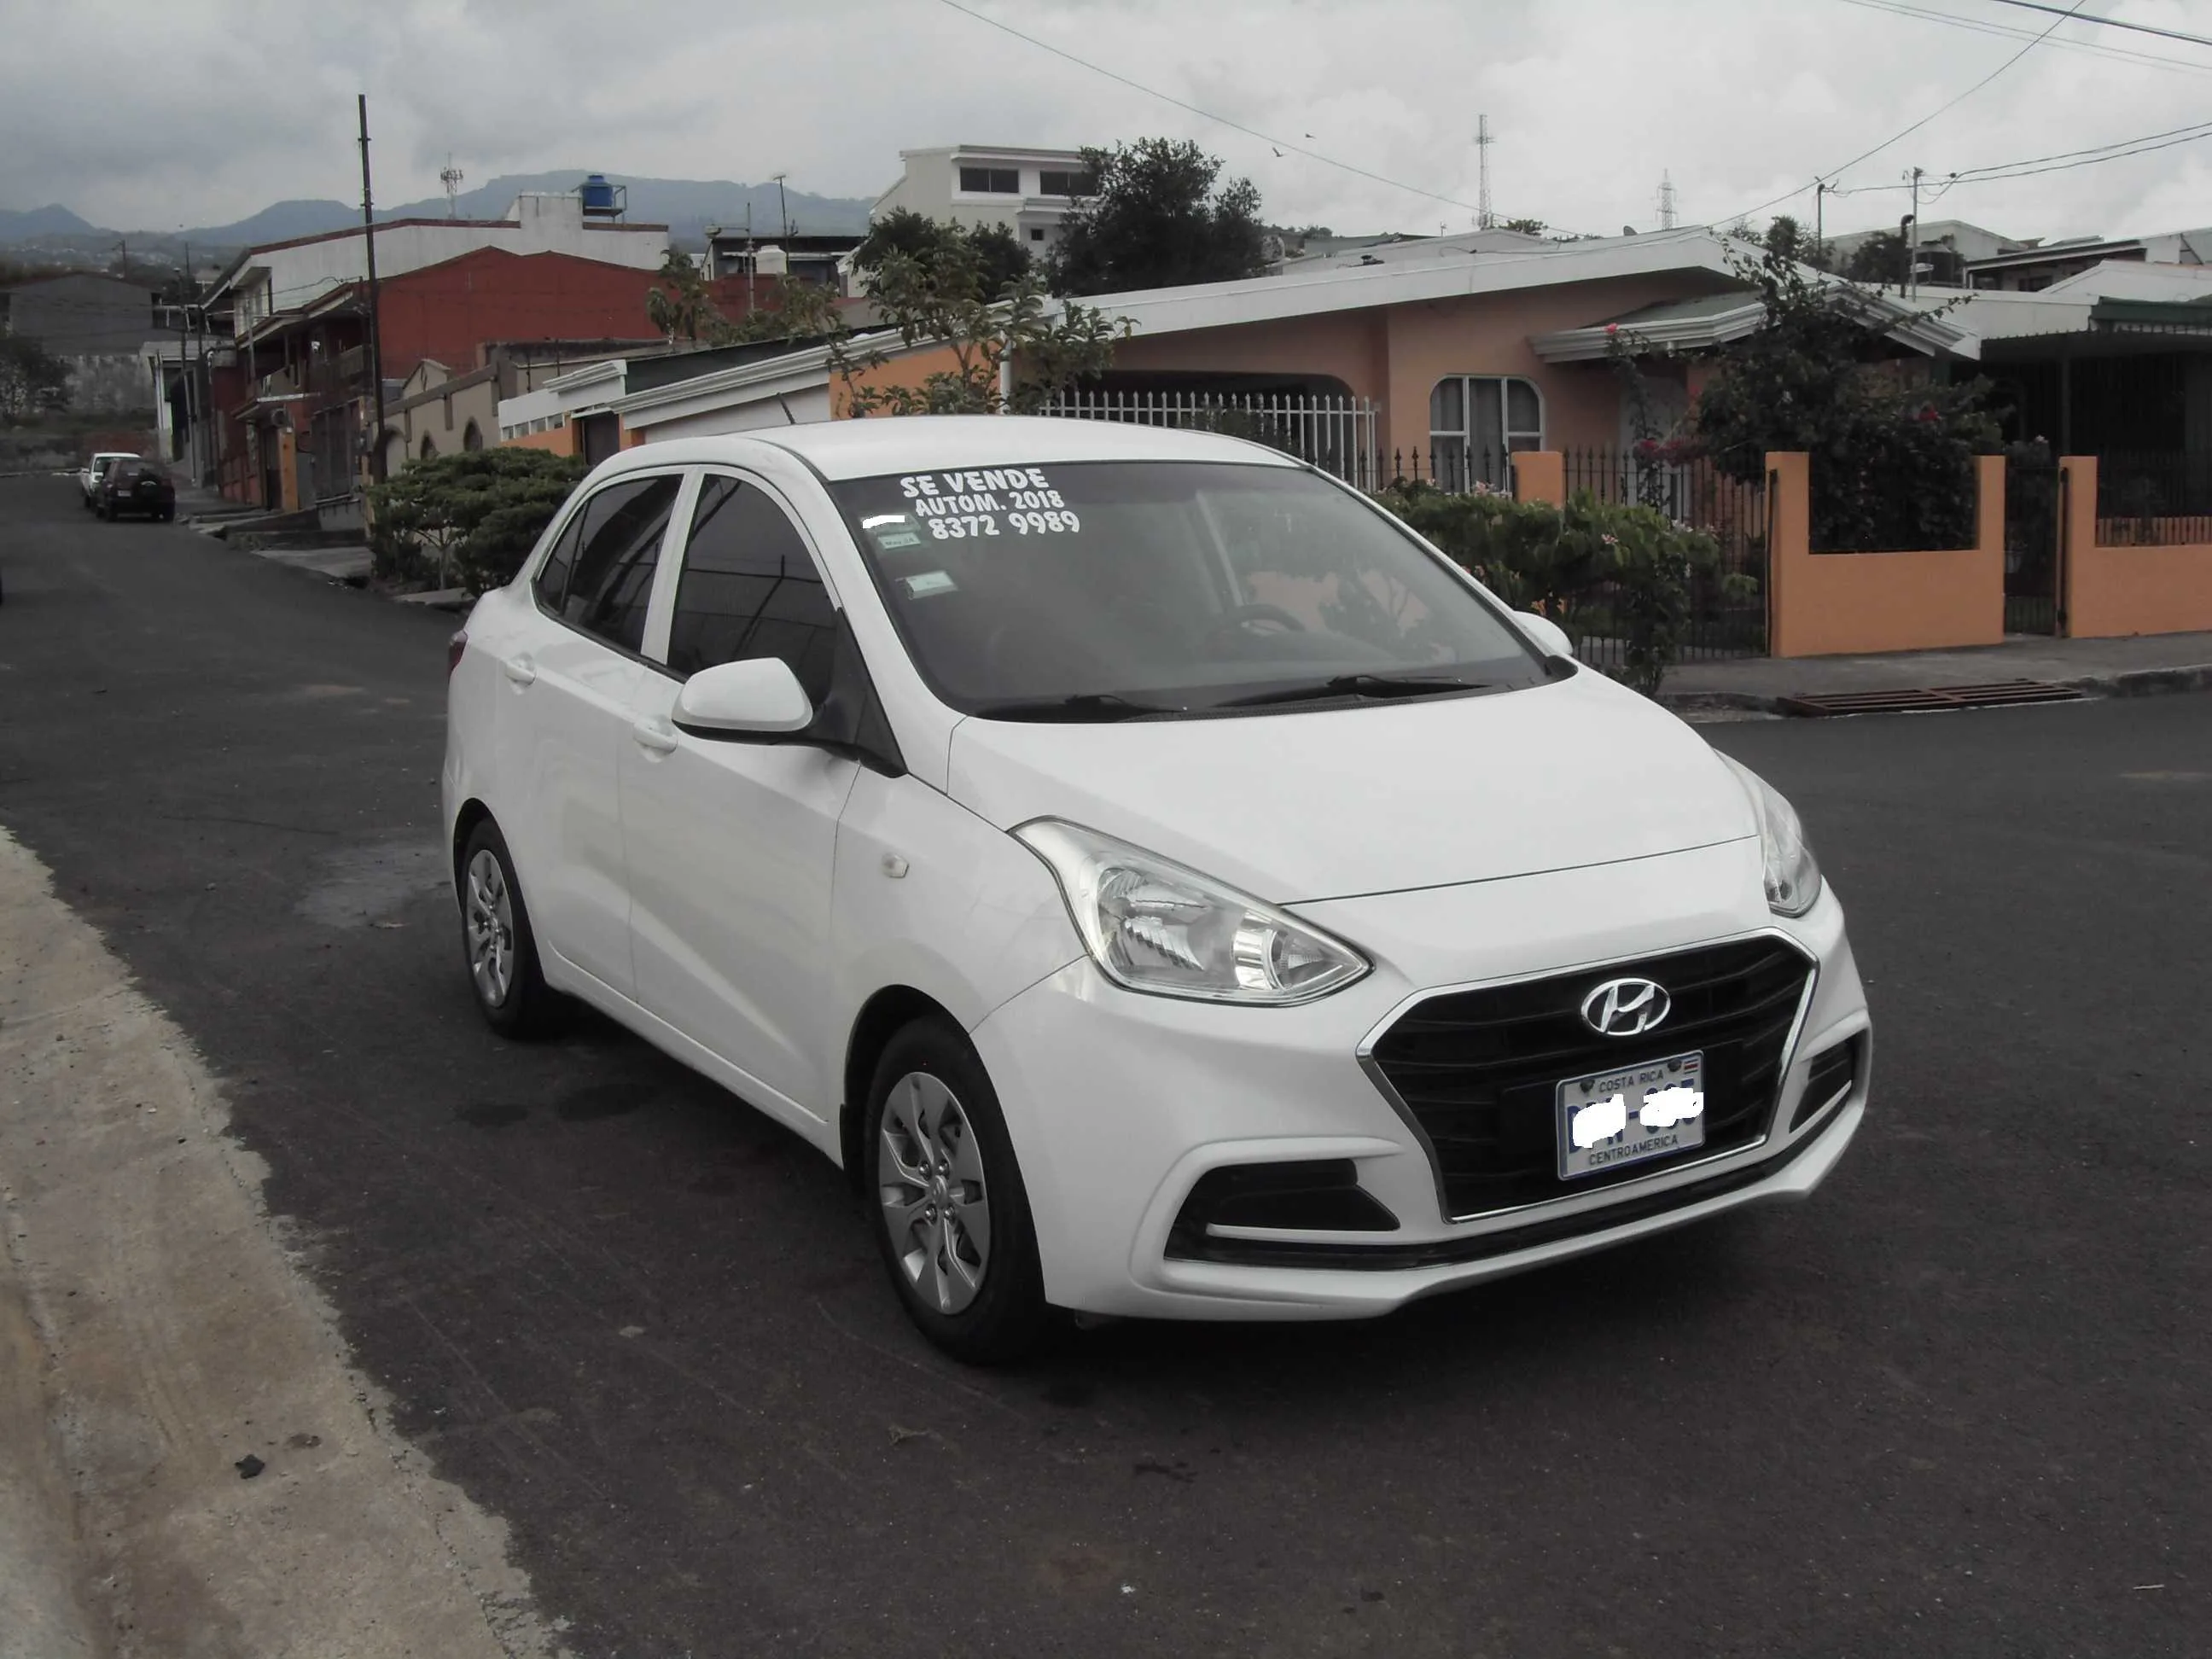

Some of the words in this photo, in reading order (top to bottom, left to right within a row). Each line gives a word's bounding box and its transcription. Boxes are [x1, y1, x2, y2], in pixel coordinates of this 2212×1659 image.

[900, 474, 939, 498] SE
[943, 469, 1049, 492] VENDE
[915, 493, 1007, 517] AUTOM.
[1009, 490, 1065, 509] 2018
[928, 515, 1000, 539] 8372
[1008, 510, 1080, 534] 9989
[1598, 1075, 1634, 1092] COSTA
[1639, 1069, 1663, 1083] RICA
[1589, 1134, 1679, 1165] CENTROAMERICA
